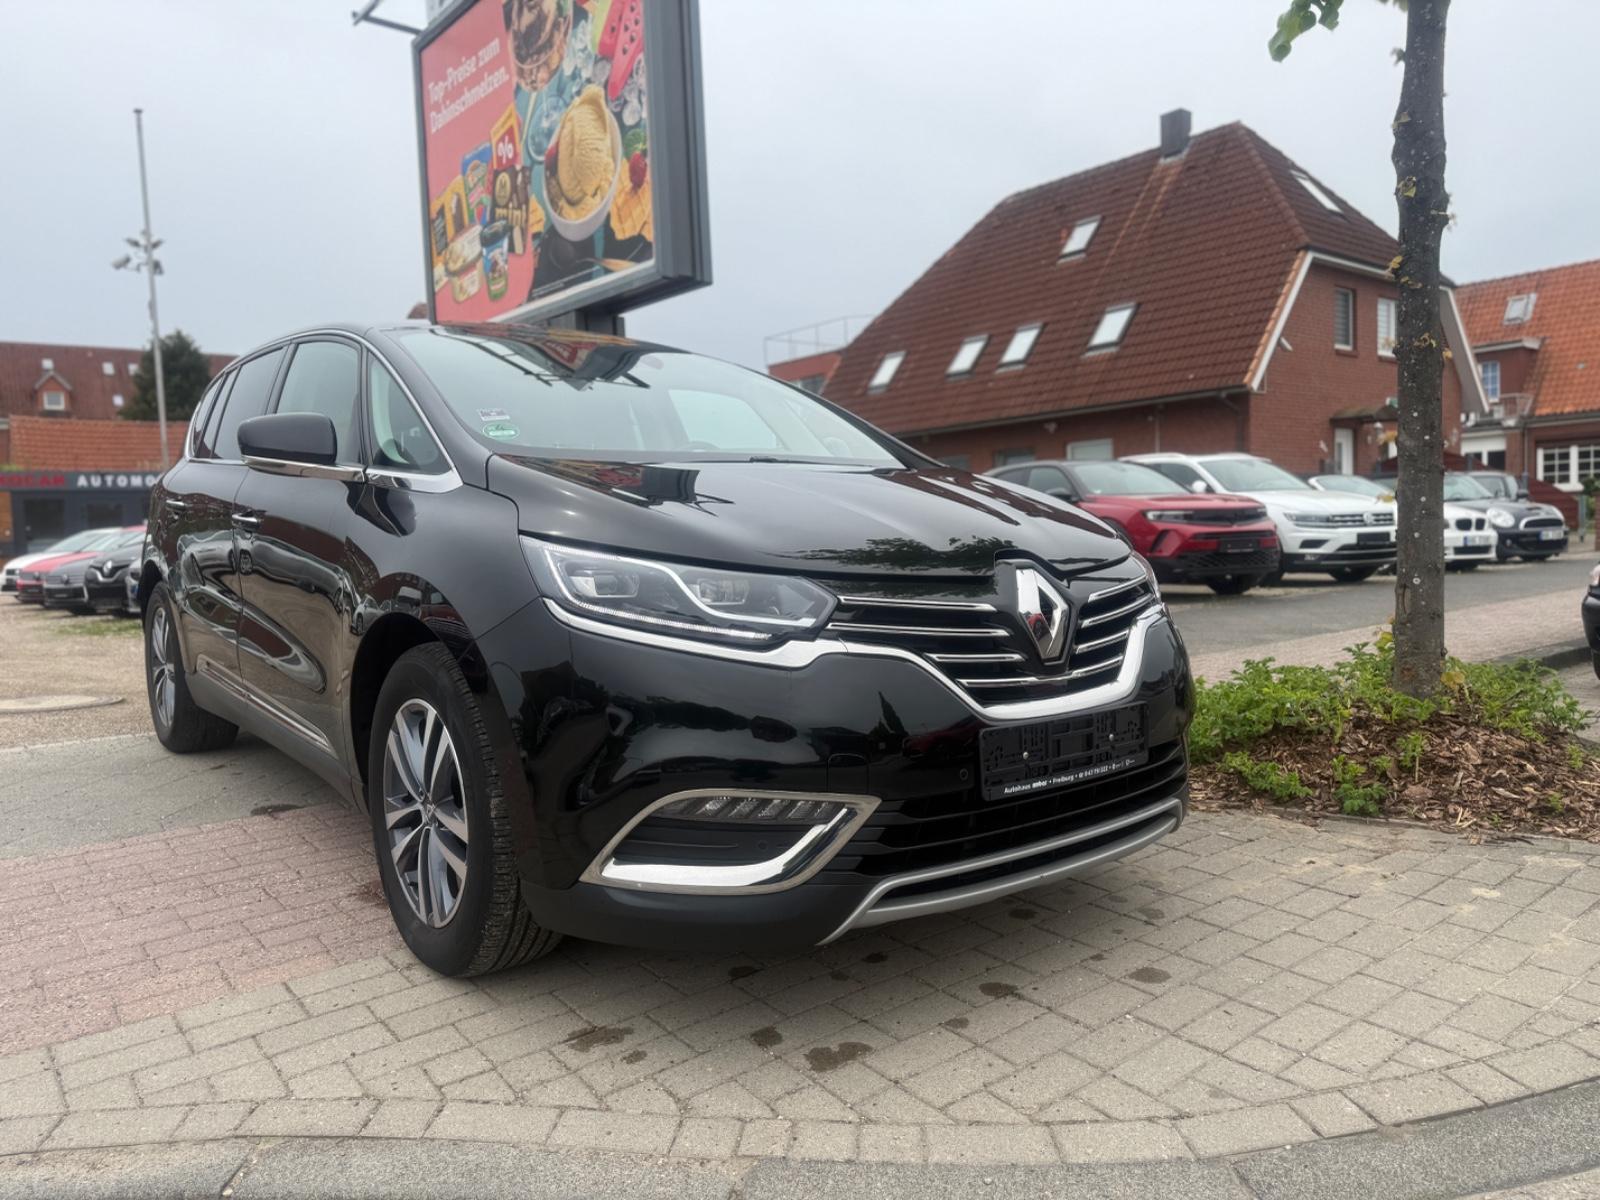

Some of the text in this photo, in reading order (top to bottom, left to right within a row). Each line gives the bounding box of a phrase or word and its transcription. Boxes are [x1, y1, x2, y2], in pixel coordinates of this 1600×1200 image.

[428, 37, 500, 105] Top-Preise zum
[1004, 783, 1031, 794] Autohaus
